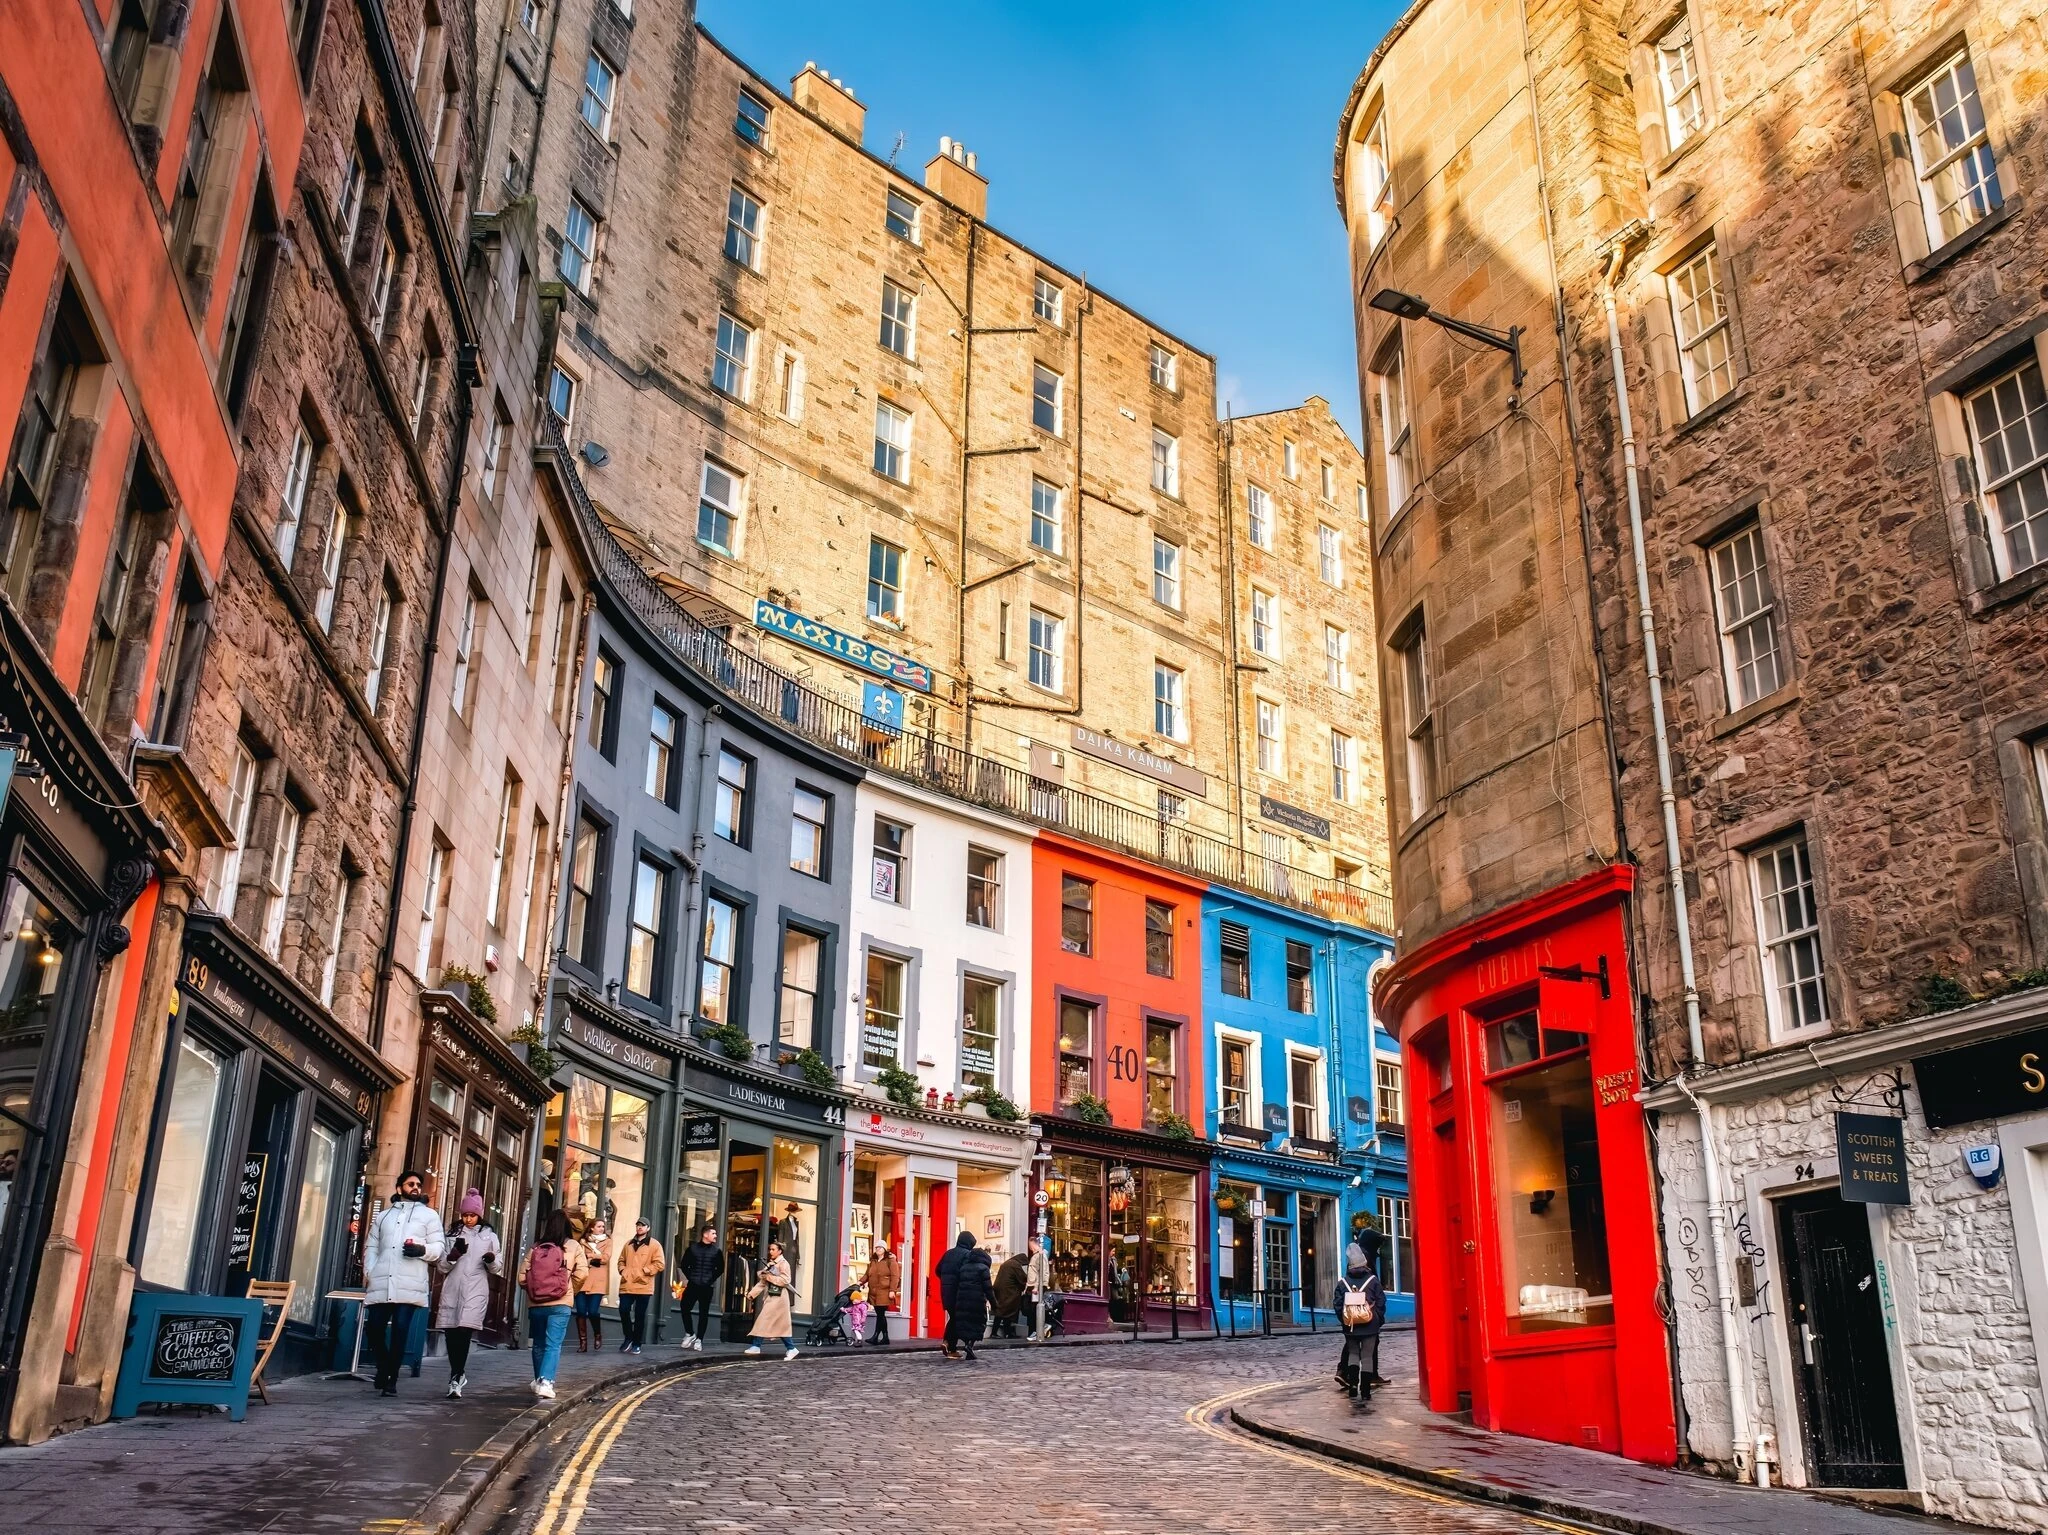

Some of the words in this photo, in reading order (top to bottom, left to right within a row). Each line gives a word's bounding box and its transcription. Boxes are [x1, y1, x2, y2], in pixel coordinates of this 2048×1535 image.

[698, 613, 731, 624] CASTLE
[701, 608, 720, 616] THE
[761, 605, 892, 671] MAXIES
[1077, 728, 1122, 757] DAIKA
[1128, 748, 1173, 775] KANAM
[42, 774, 60, 814] CO.
[189, 957, 208, 991] 89
[1477, 938, 1553, 993] CUBITTS
[864, 1024, 881, 1035] oving
[881, 1026, 897, 1038] Local
[583, 1025, 618, 1056] Walker
[623, 1044, 657, 1072] Slater
[879, 1045, 894, 1058] 2003
[1107, 1045, 1139, 1083] 40
[2020, 1053, 2046, 1093] S
[1596, 1069, 1634, 1092] WEST
[357, 1091, 370, 1115] 89
[729, 1084, 785, 1111] LADIESWEAR
[1601, 1087, 1630, 1106] BOW
[823, 1105, 845, 1125] 44.
[1272, 1117, 1287, 1127] BLEUE
[1356, 1111, 1370, 1121] BLEUE
[860, 1117, 871, 1129] the
[871, 1122, 881, 1131] red
[882, 1122, 898, 1135] door
[901, 1127, 925, 1140] gallery
[961, 1139, 1013, 1152] www.edinburghart.com
[1848, 1133, 1895, 1148] SCOTTISH
[1854, 1151, 1893, 1165] SWEETS
[1794, 1163, 1815, 1180] 94
[1852, 1170, 1860, 1180] &
[1863, 1170, 1899, 1183] TREATS
[1036, 1193, 1048, 1203] 20
[171, 1321, 194, 1332] TAKE
[175, 1330, 215, 1349] COFFEE
[166, 1342, 210, 1362] Cakes
[173, 1357, 223, 1374] SANDWICHES
